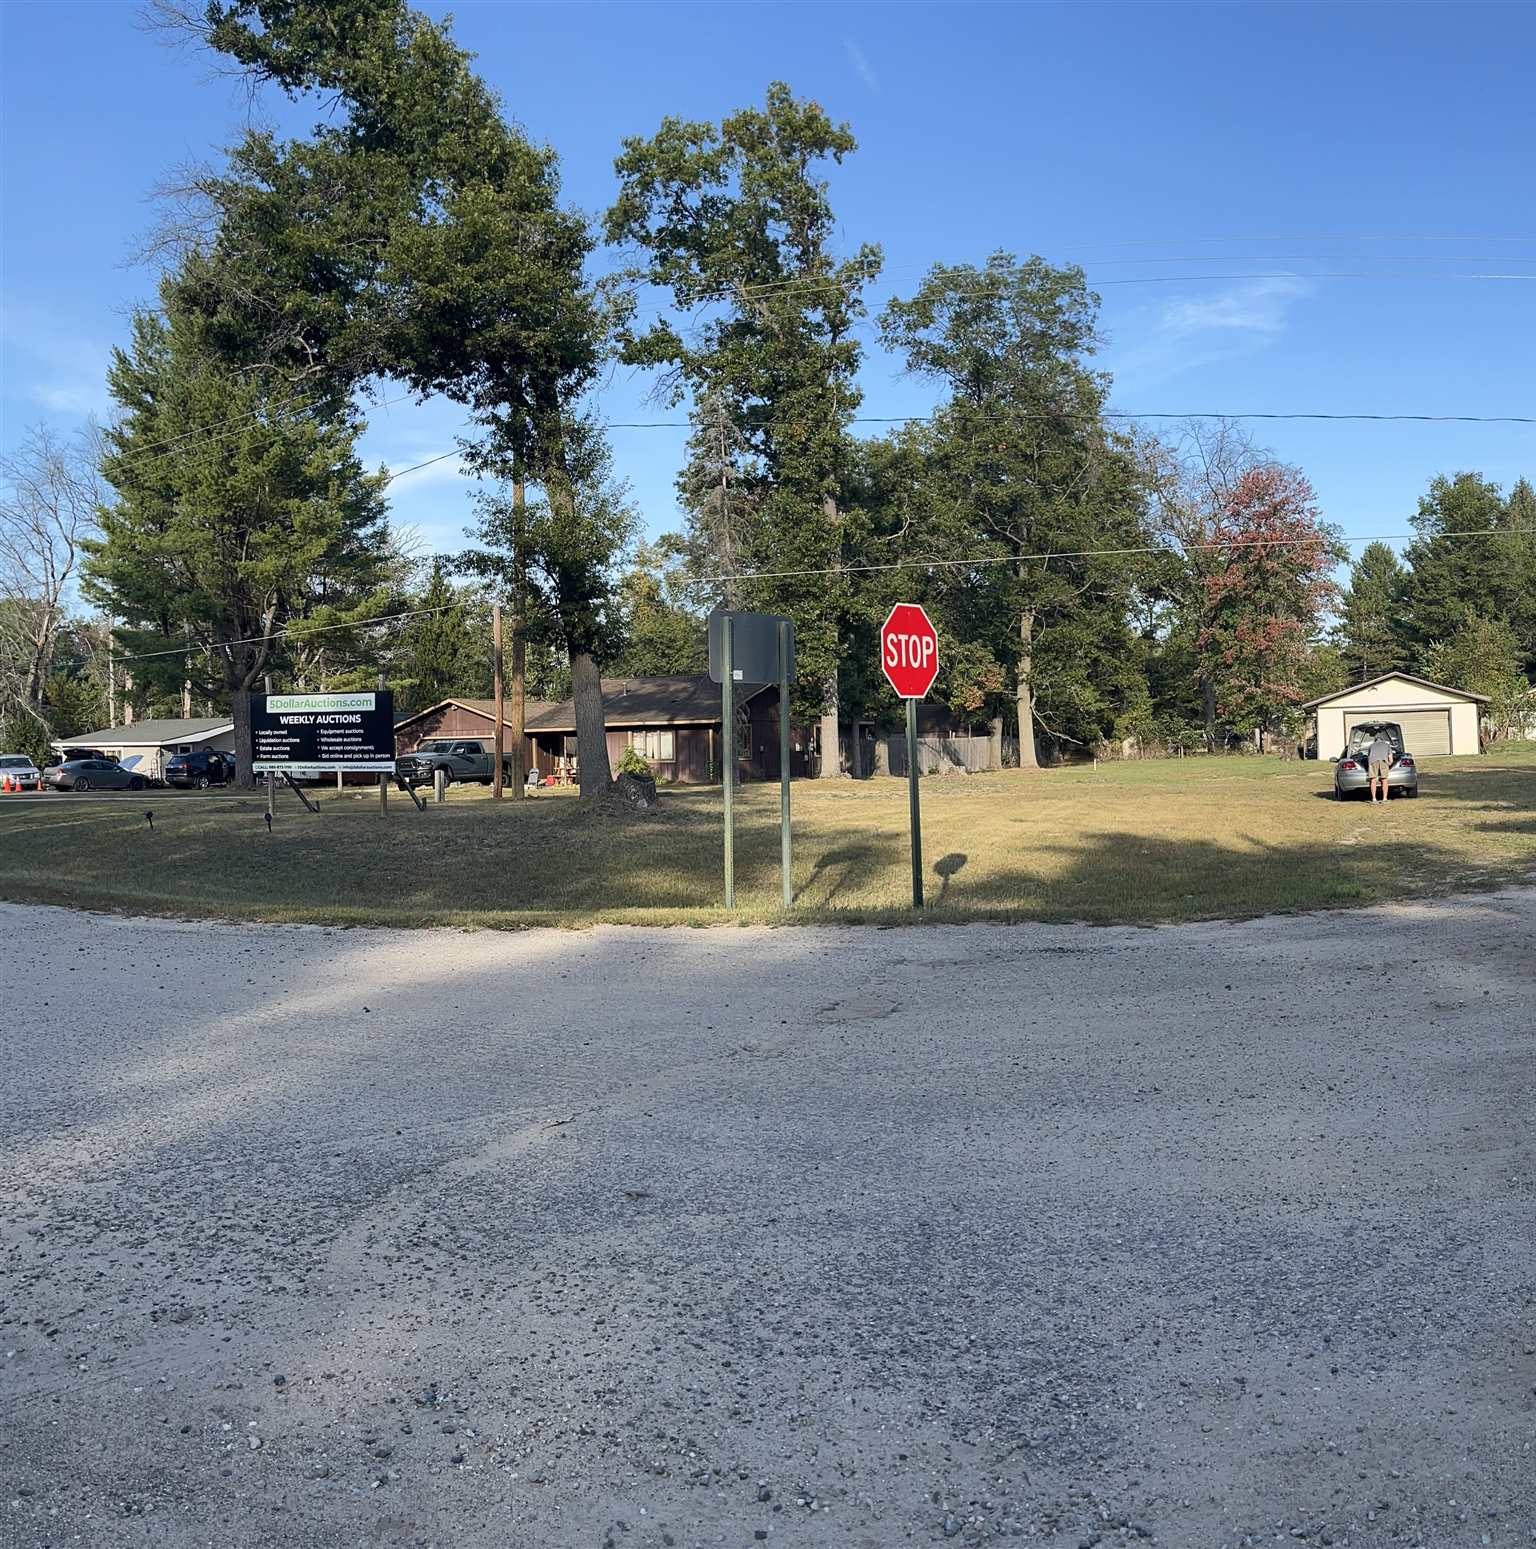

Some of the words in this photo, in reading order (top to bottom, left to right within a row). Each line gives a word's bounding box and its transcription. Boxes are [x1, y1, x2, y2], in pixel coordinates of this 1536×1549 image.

[886, 633, 934, 668] STOP
[270, 697, 372, 709] 5DollarAuctions.com
[280, 715, 315, 724] WEEKLY
[316, 714, 362, 724] AUCTIONS
